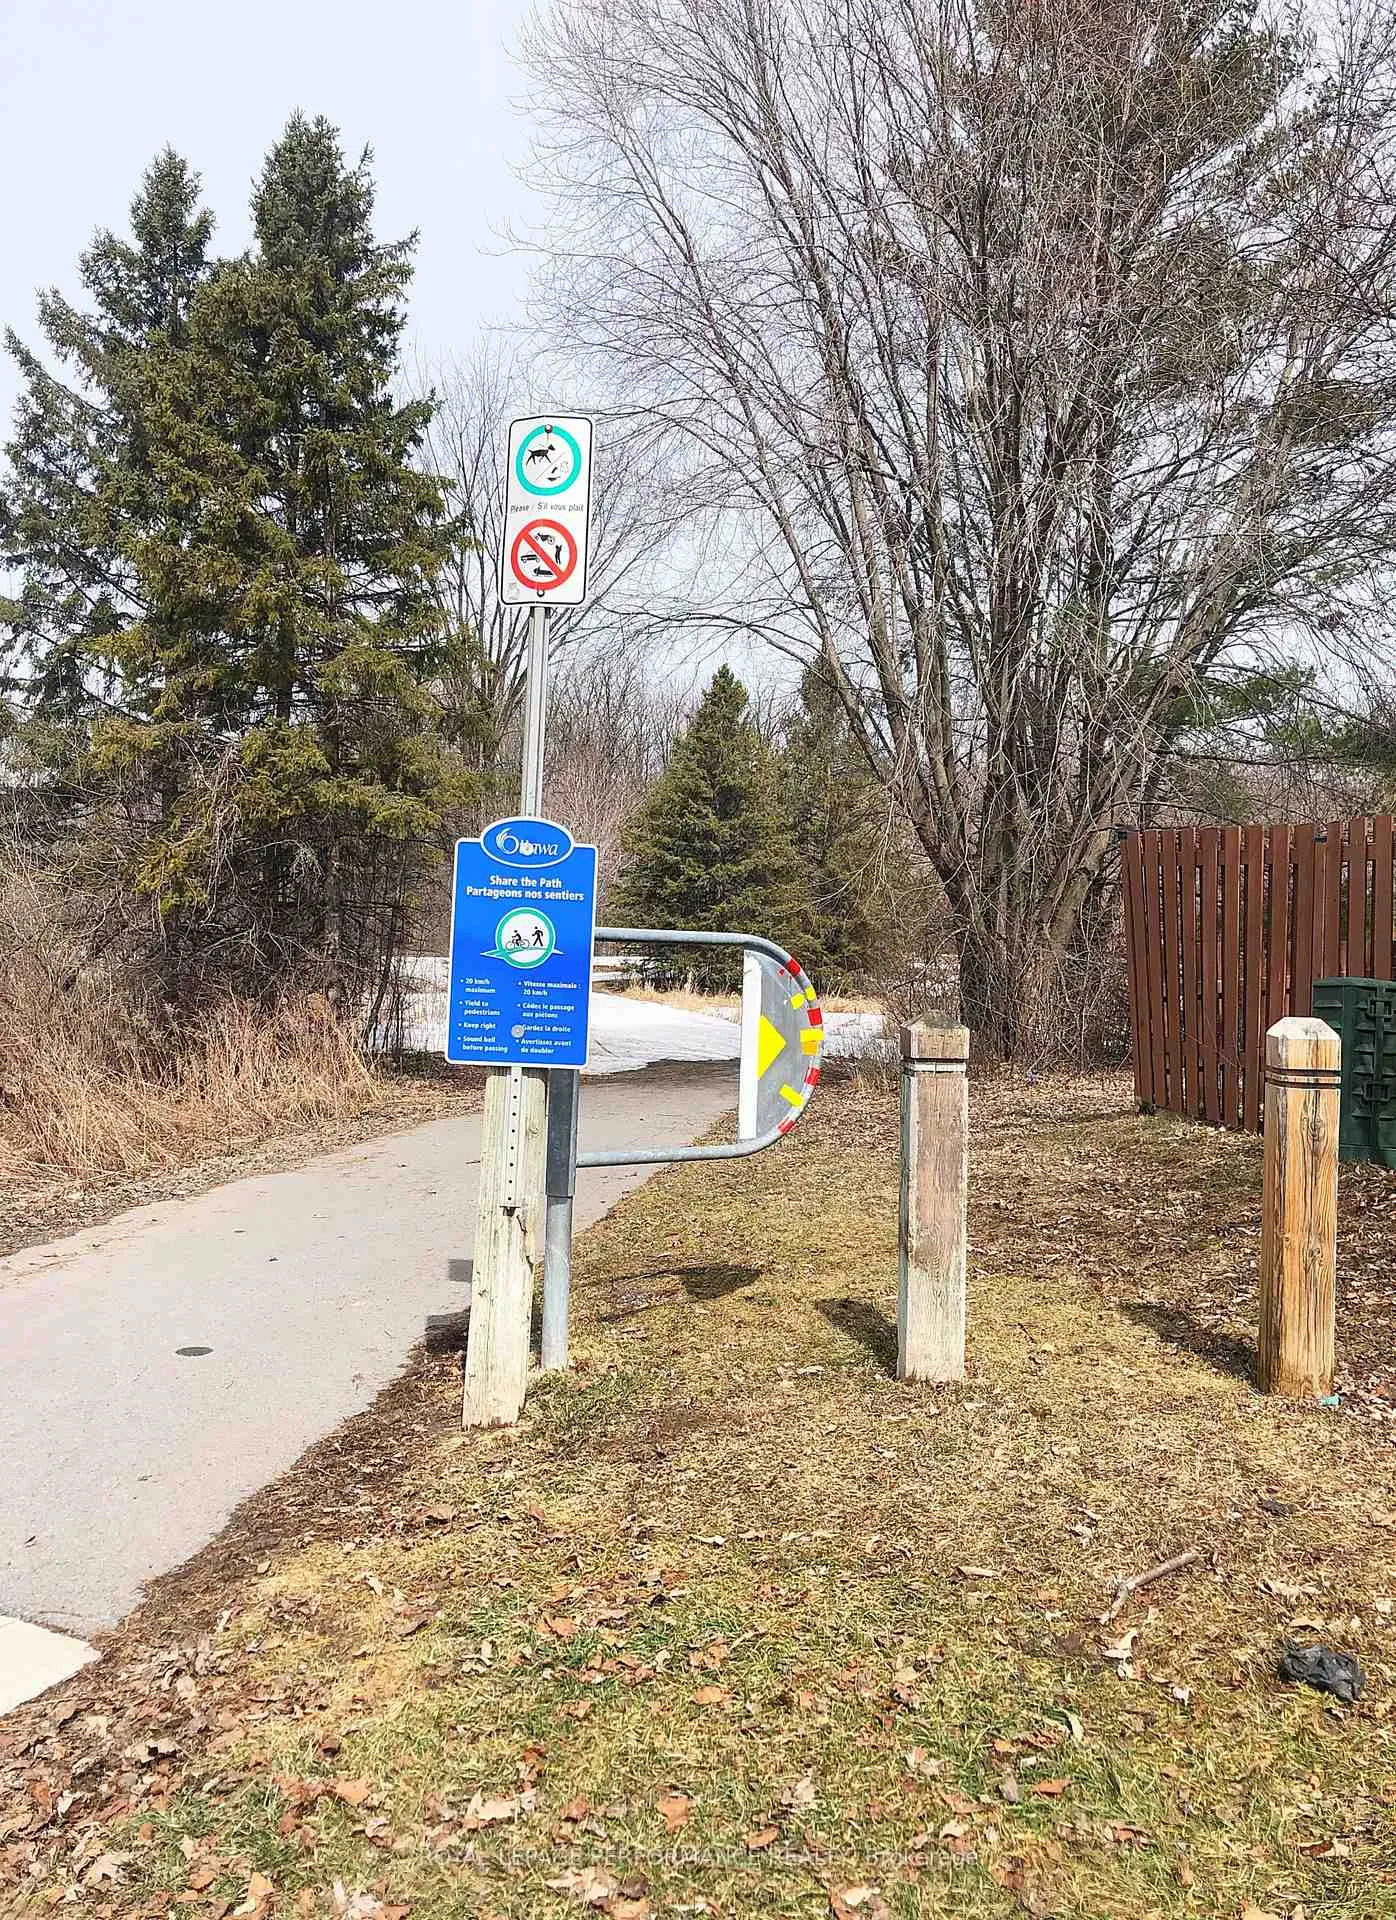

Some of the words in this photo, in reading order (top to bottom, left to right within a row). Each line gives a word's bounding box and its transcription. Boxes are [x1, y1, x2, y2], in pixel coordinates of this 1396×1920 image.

[496, 827, 558, 855] Oawa
[489, 875, 518, 886] Share
[521, 876, 537, 887] the
[540, 877, 562, 888] Path
[466, 885, 522, 899] Partageons
[525, 890, 542, 899] nos
[544, 890, 584, 901] sentiers
[474, 977, 490, 985] km/h
[523, 980, 545, 988] Vitesse
[546, 981, 577, 989] maximale
[464, 999, 480, 1007] Yield
[463, 1008, 501, 1017] pedestrians
[549, 1004, 575, 1012] passage
[463, 1021, 479, 1030] Keep
[480, 1021, 496, 1031] right
[521, 1024, 543, 1032] Gardez
[544, 1024, 551, 1032] la
[551, 1024, 571, 1033] droite
[463, 1035, 482, 1043] Sound
[520, 1038, 553, 1046] Avertissez
[553, 1039, 572, 1047] avant
[462, 1043, 483, 1051] before
[484, 1045, 508, 1054] passing
[530, 1046, 554, 1055] doubler
